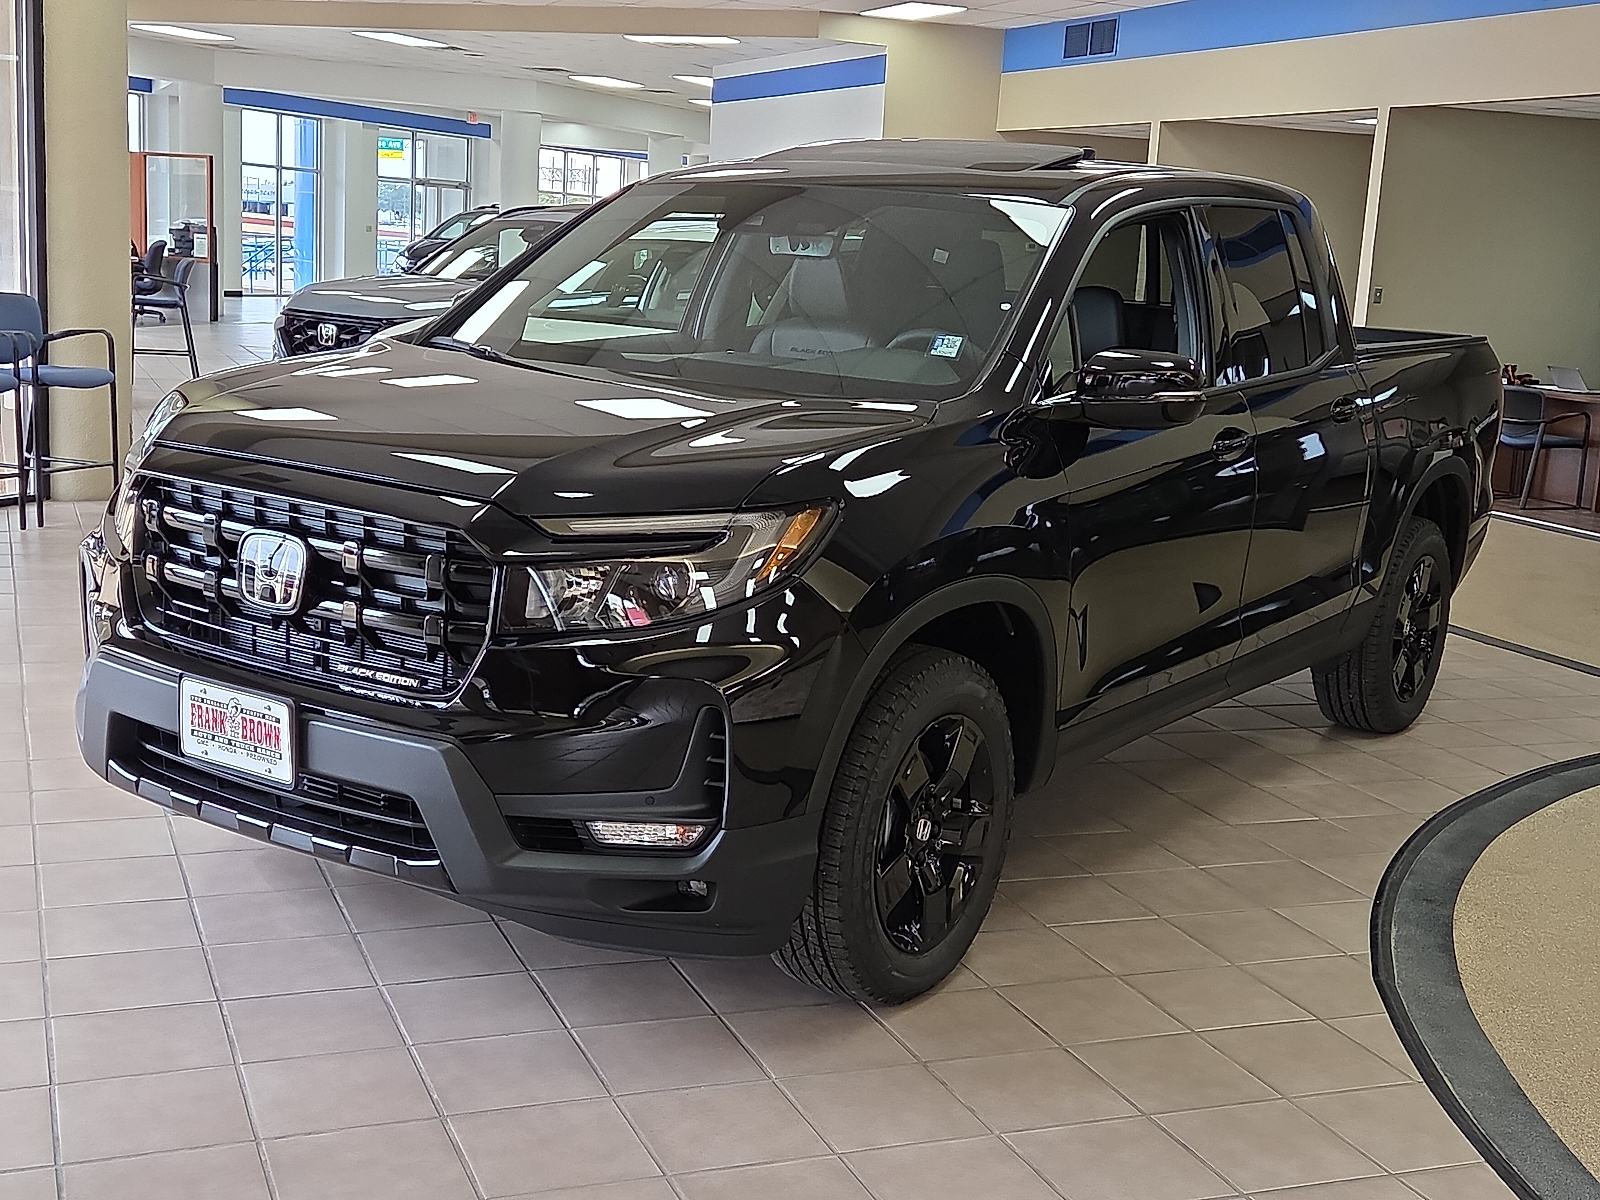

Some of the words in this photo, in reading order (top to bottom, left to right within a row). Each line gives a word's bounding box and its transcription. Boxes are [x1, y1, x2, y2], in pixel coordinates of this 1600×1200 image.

[337, 664, 375, 679] BLACK
[375, 672, 420, 688] EDITION
[190, 703, 228, 735] FRANK
[241, 716, 282, 751] BROWN
[193, 731, 213, 741] AUTO
[214, 735, 229, 745] AND
[231, 739, 255, 753] TRUCK
[256, 746, 281, 759] RANCH
[196, 739, 209, 747] GMC
[218, 744, 237, 754] HONDA
[246, 752, 278, 766] PREOWNED
